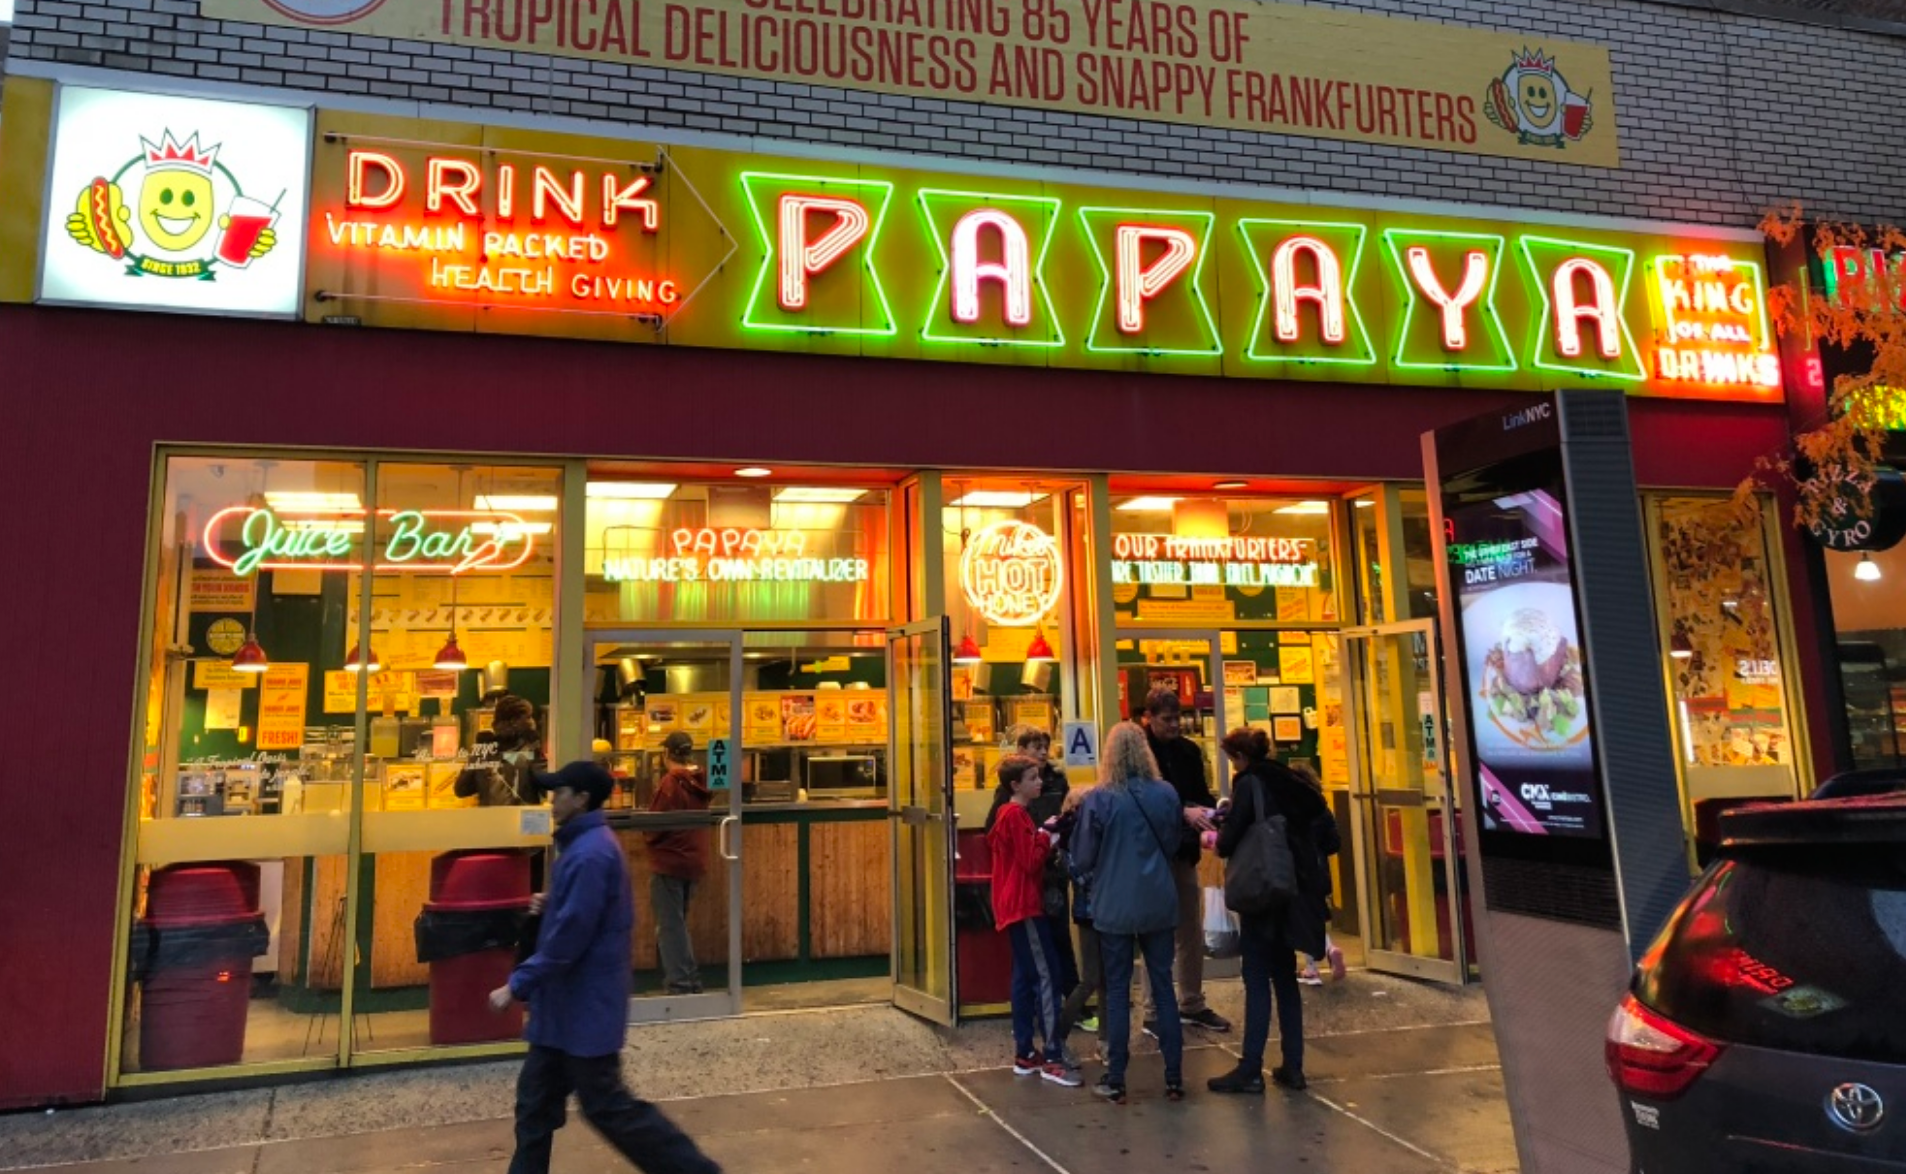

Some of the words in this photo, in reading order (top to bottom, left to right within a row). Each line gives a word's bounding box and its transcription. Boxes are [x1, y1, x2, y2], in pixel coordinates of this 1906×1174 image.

[1022, 0, 1070, 44] 85
[1082, 0, 1198, 58] YEARS
[1209, 9, 1250, 64] OF
[664, 4, 977, 93] DELICIOUSNESS
[988, 42, 1065, 102] AND
[1076, 51, 1216, 117] SNAPPY
[1226, 69, 1478, 145] FRANKFURTERS
[348, 151, 659, 231] DRINK
[325, 212, 465, 252] VITAMIN
[431, 256, 553, 295] HEALTH
[571, 273, 678, 304] GIVING
[777, 192, 1621, 359] PAPAYA
[1662, 278, 1754, 315] KING
[1659, 347, 1780, 386] DRINKS
[1502, 402, 1551, 431] LinkNYC
[233, 508, 352, 576] Juice
[384, 510, 475, 563] Bar
[672, 527, 806, 558] PAPAYA
[1115, 535, 1158, 558] OUR
[604, 556, 699, 581] NATURE'S
[975, 557, 1049, 596] HOT
[1465, 566, 1497, 584] DATE
[979, 592, 1051, 616] HONEY
[262, 730, 299, 745] FRESH!
[1069, 727, 1092, 754] A
[1425, 714, 1436, 748] ATM
[711, 739, 727, 776] ATM
